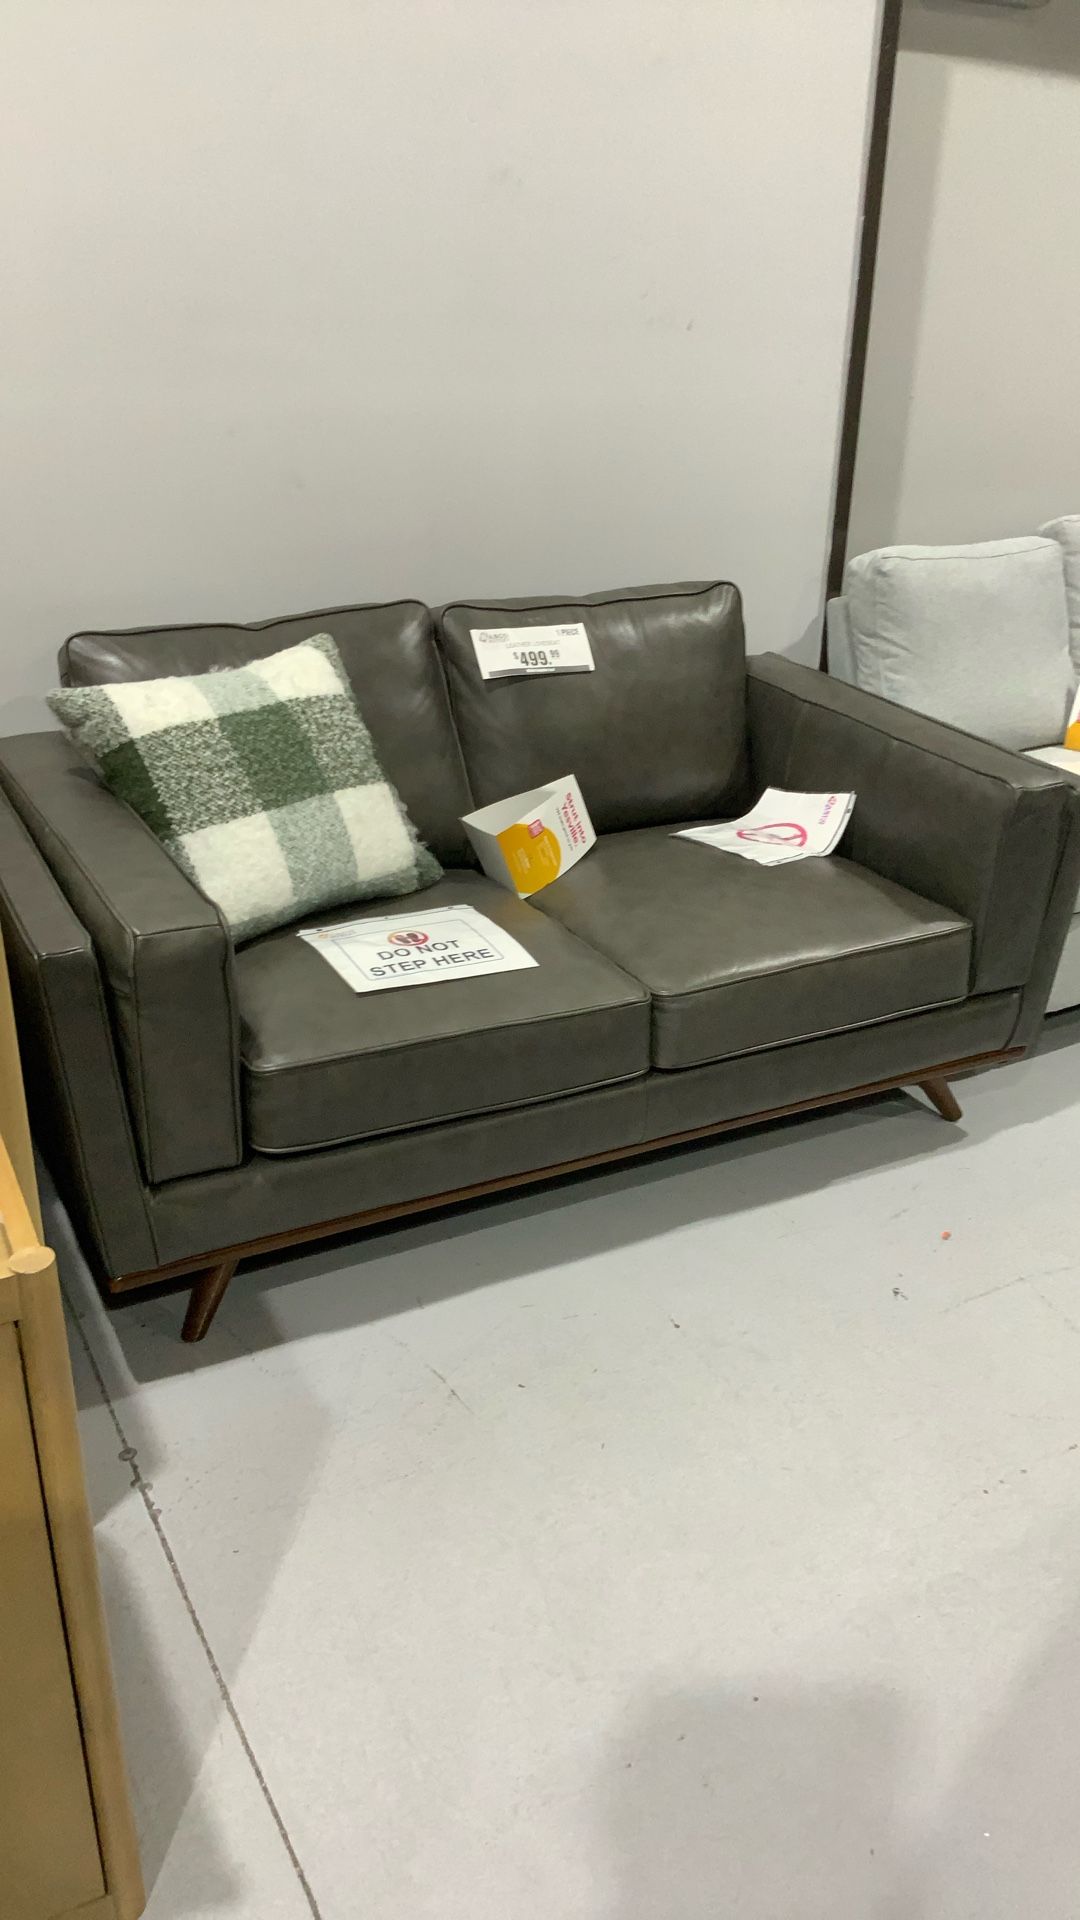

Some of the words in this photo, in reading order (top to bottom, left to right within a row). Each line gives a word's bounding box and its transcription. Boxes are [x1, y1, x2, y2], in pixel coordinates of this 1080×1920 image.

[561, 628, 579, 636] PIECE
[566, 792, 579, 820] Strut
[369, 958, 426, 977] STEP
[433, 948, 494, 967] HERE
[376, 947, 411, 961] DO
[414, 939, 460, 954] NOT
